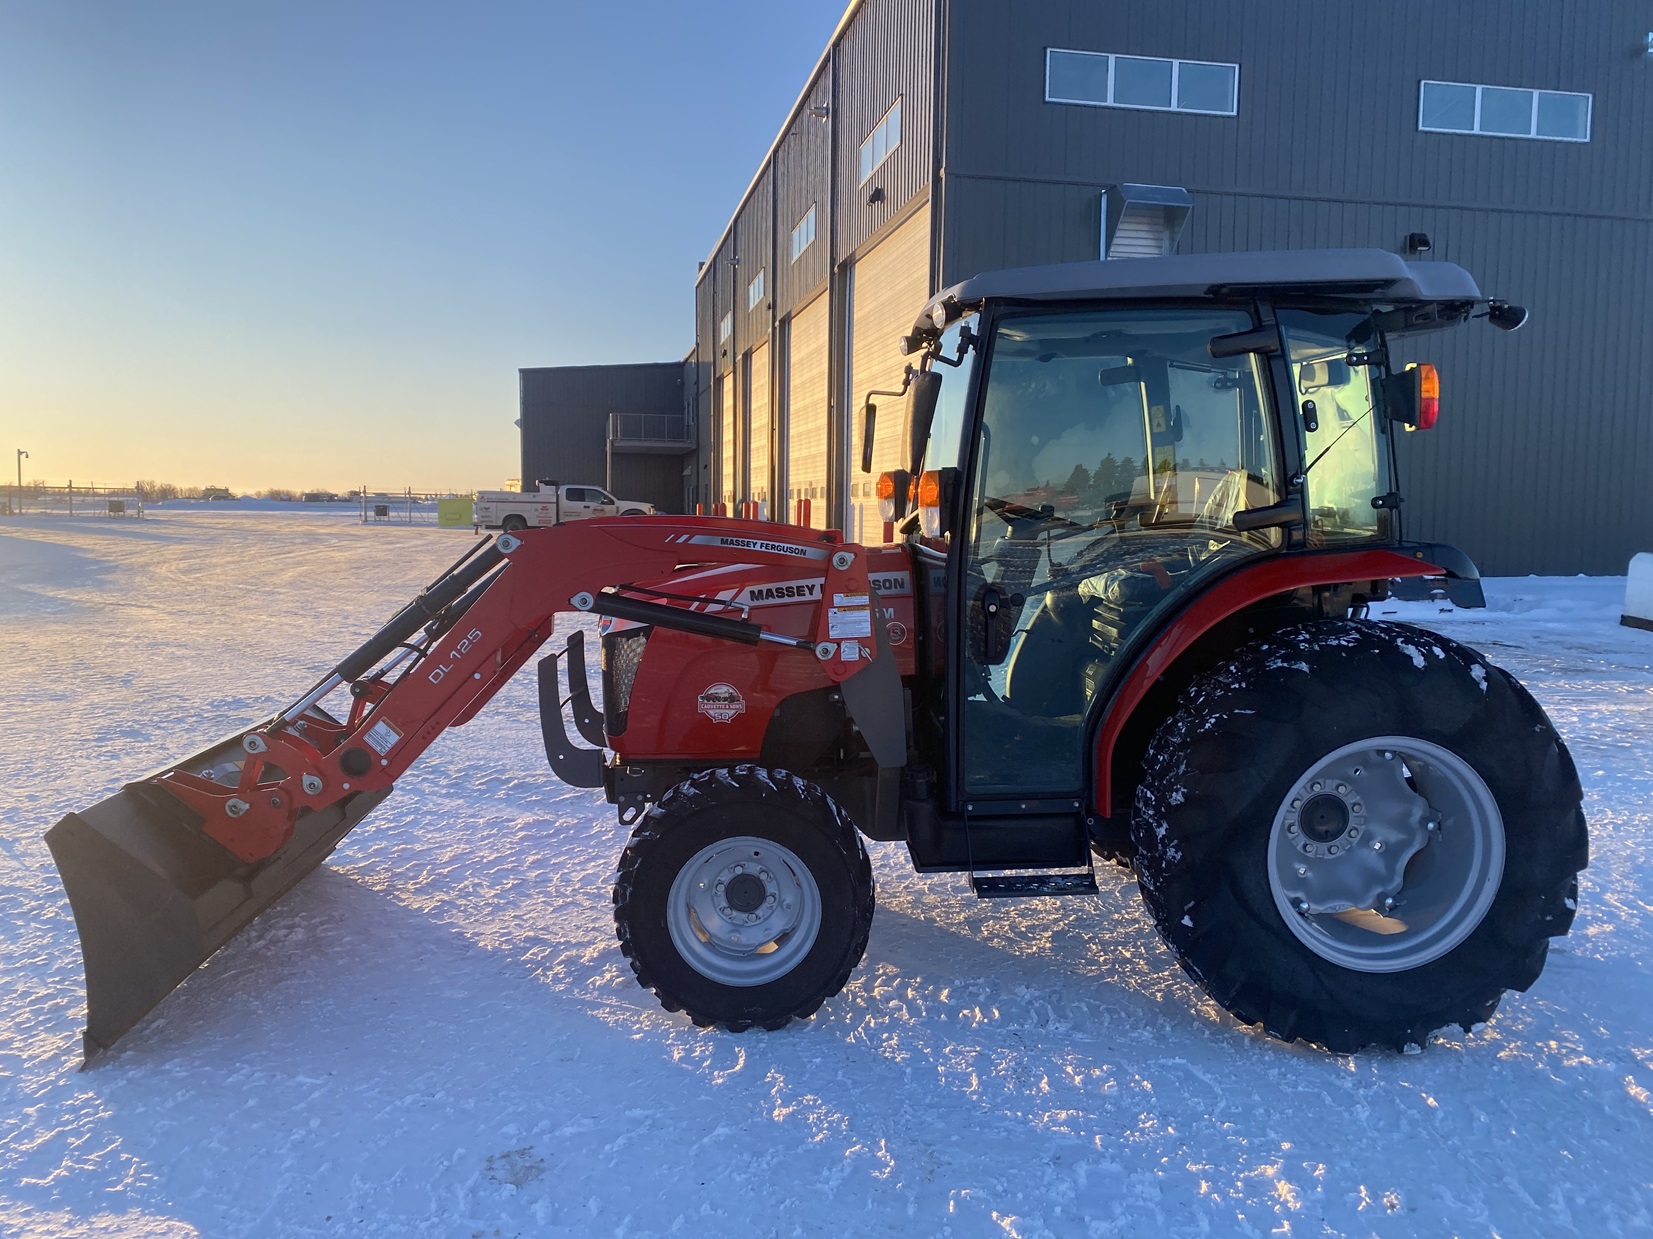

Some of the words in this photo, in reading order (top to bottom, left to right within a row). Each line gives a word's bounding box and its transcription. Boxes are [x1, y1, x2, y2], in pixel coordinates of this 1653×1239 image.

[720, 537, 758, 549] MASSEY
[759, 542, 807, 557] FERGUSON
[749, 584, 816, 602] MASSEY
[428, 664, 454, 684] DL
[450, 628, 482, 659] 125
